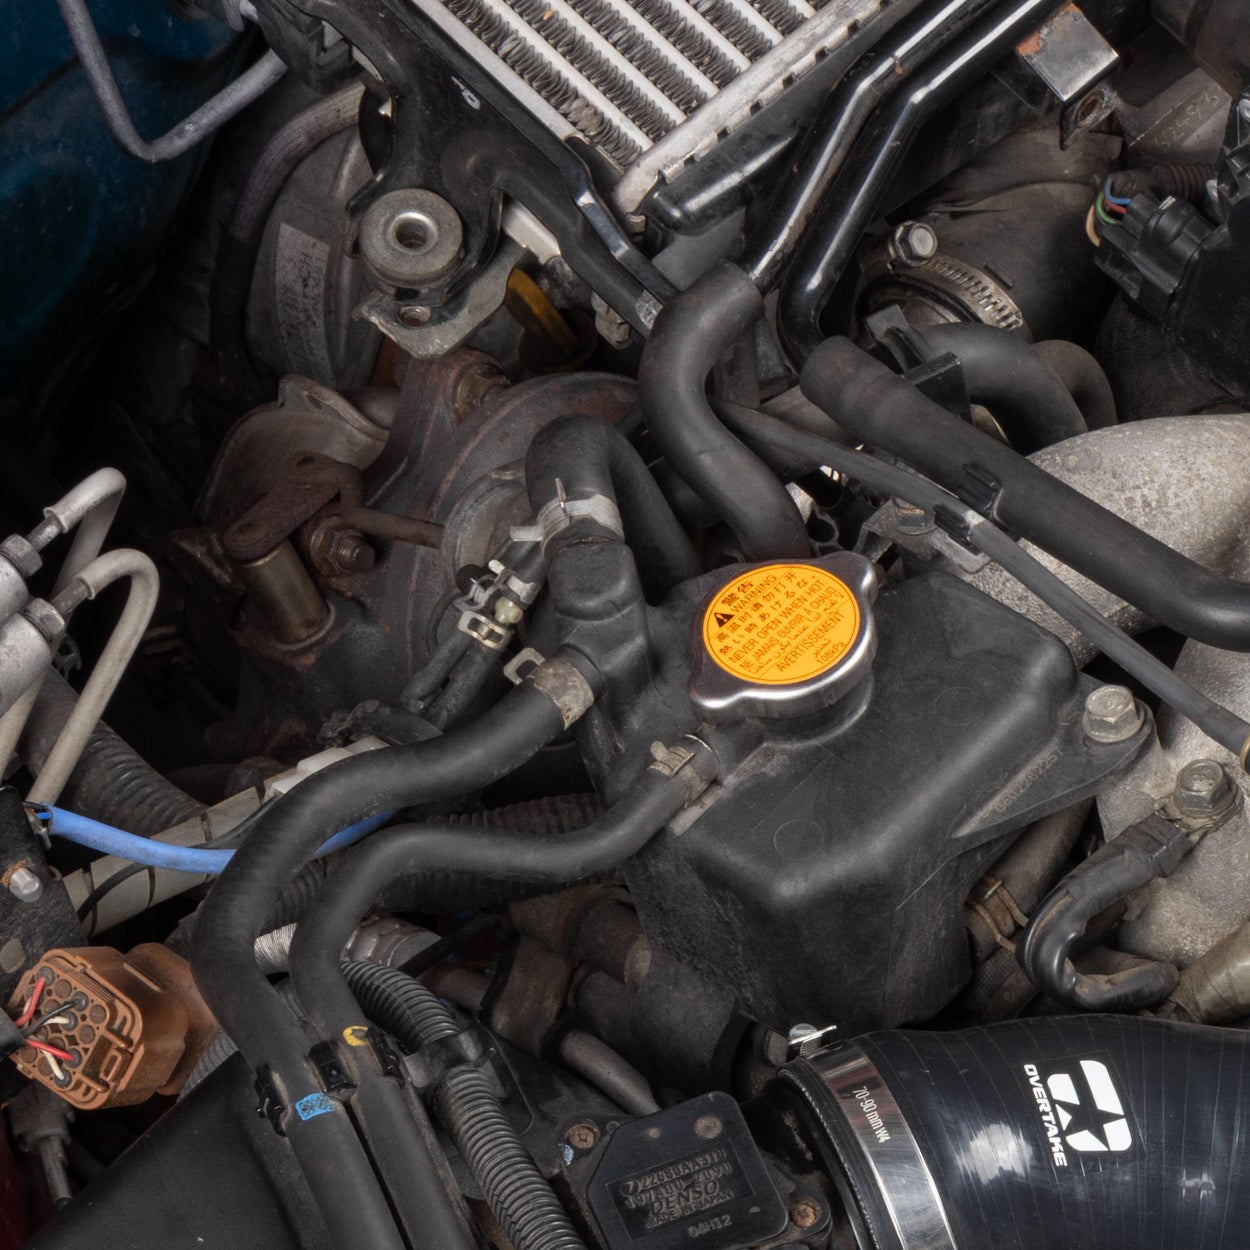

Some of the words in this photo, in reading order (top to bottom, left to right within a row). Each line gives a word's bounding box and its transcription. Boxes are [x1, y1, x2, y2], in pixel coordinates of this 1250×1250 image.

[721, 579, 755, 608] 警告
[730, 572, 777, 614] WARNING
[728, 632, 761, 664] NEVER
[757, 614, 781, 639] OPEN
[779, 591, 808, 619] WHEN
[739, 657, 753, 671] NE
[751, 635, 779, 661] JAMAIS
[776, 611, 806, 639] OUVRIR
[776, 610, 843, 671] AVERTISSEMENT
[853, 1086, 876, 1112] 70-90
[1023, 1063, 1067, 1166] OVERTAKE
[866, 1111, 883, 1129] mm
[874, 1127, 890, 1143] W4
[645, 1209, 677, 1229] MADE
[679, 1203, 693, 1216] IN
[695, 1188, 734, 1210] JAPAN
[648, 1178, 719, 1216] DENSO
